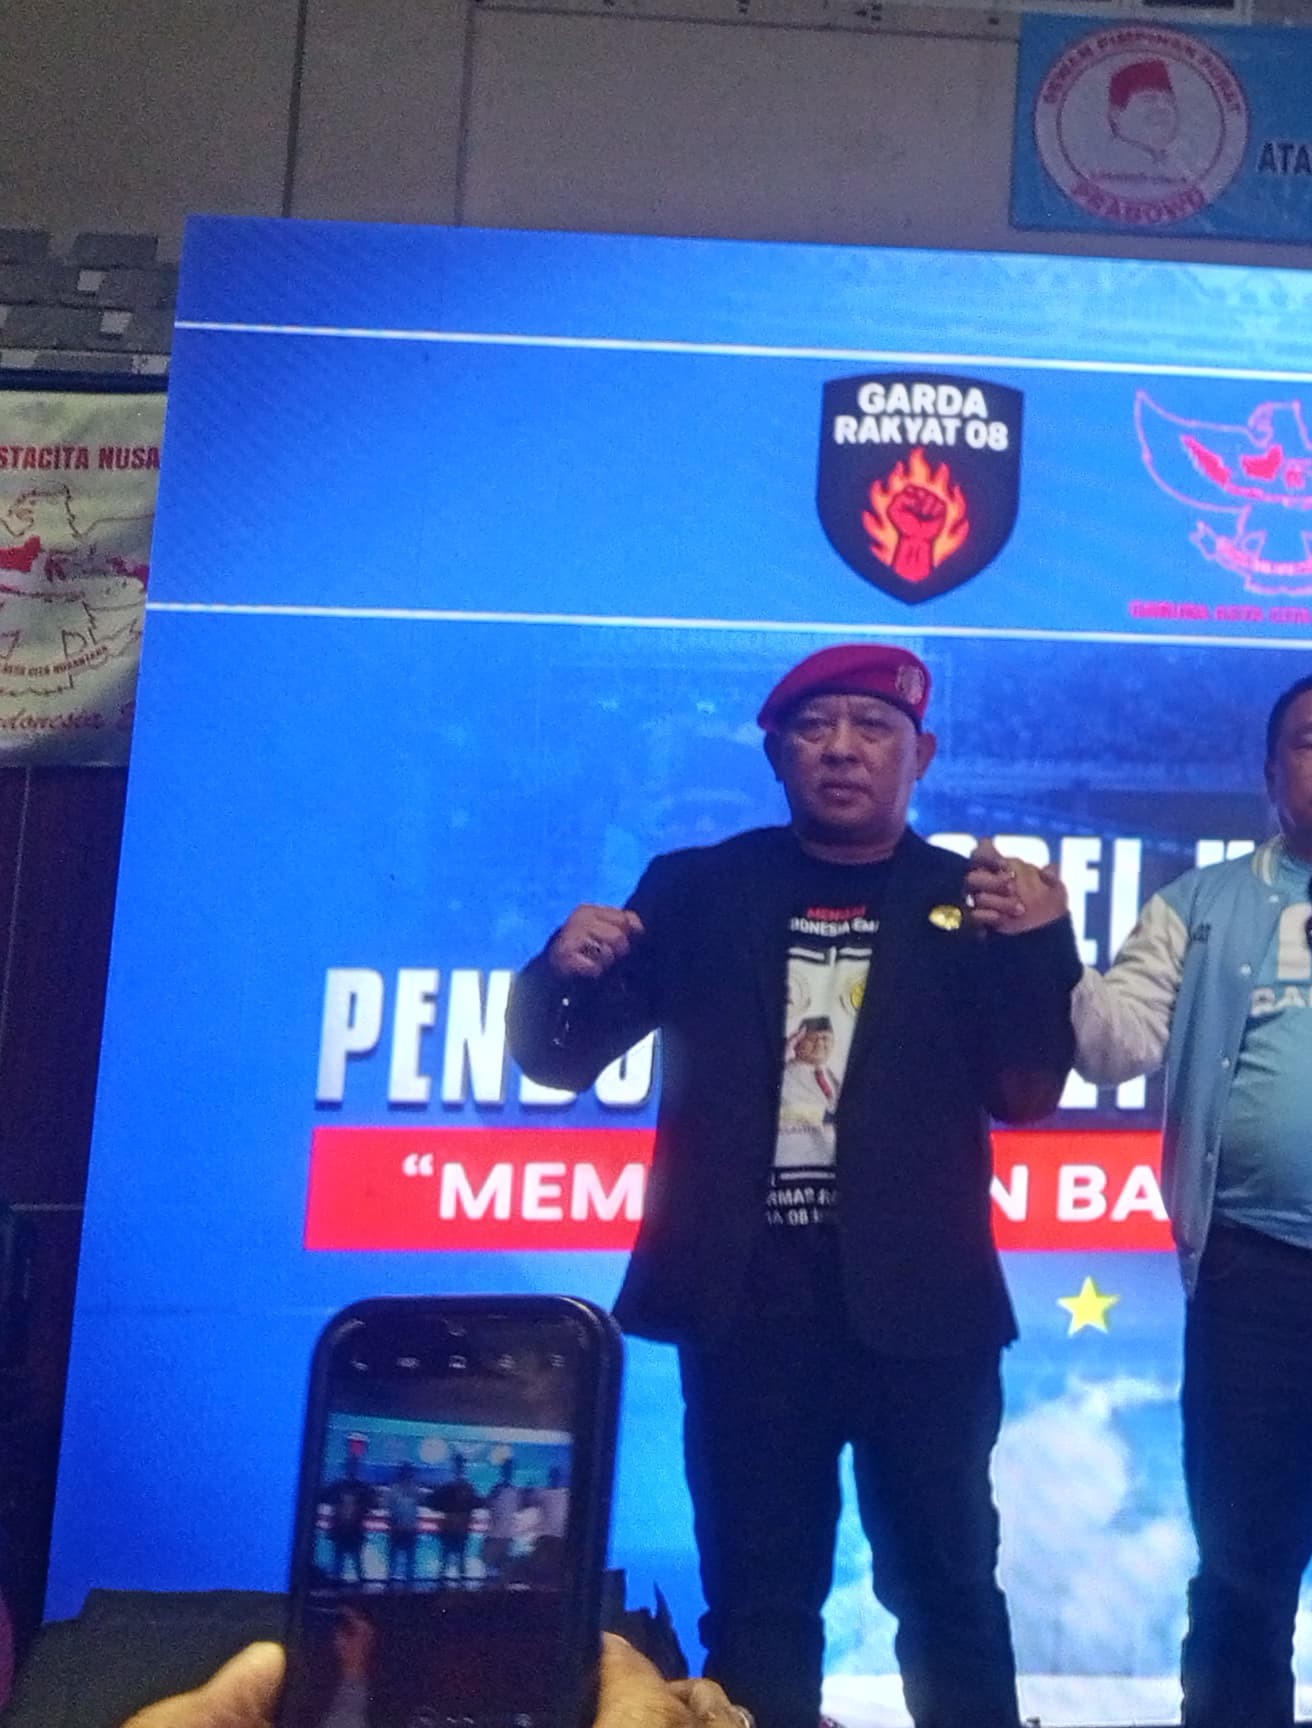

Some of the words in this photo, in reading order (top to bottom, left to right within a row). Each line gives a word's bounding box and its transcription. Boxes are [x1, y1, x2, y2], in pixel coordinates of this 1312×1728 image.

[857, 382, 989, 419] GARDA
[833, 415, 962, 447] RAKYAT
[964, 420, 1009, 451] 08
